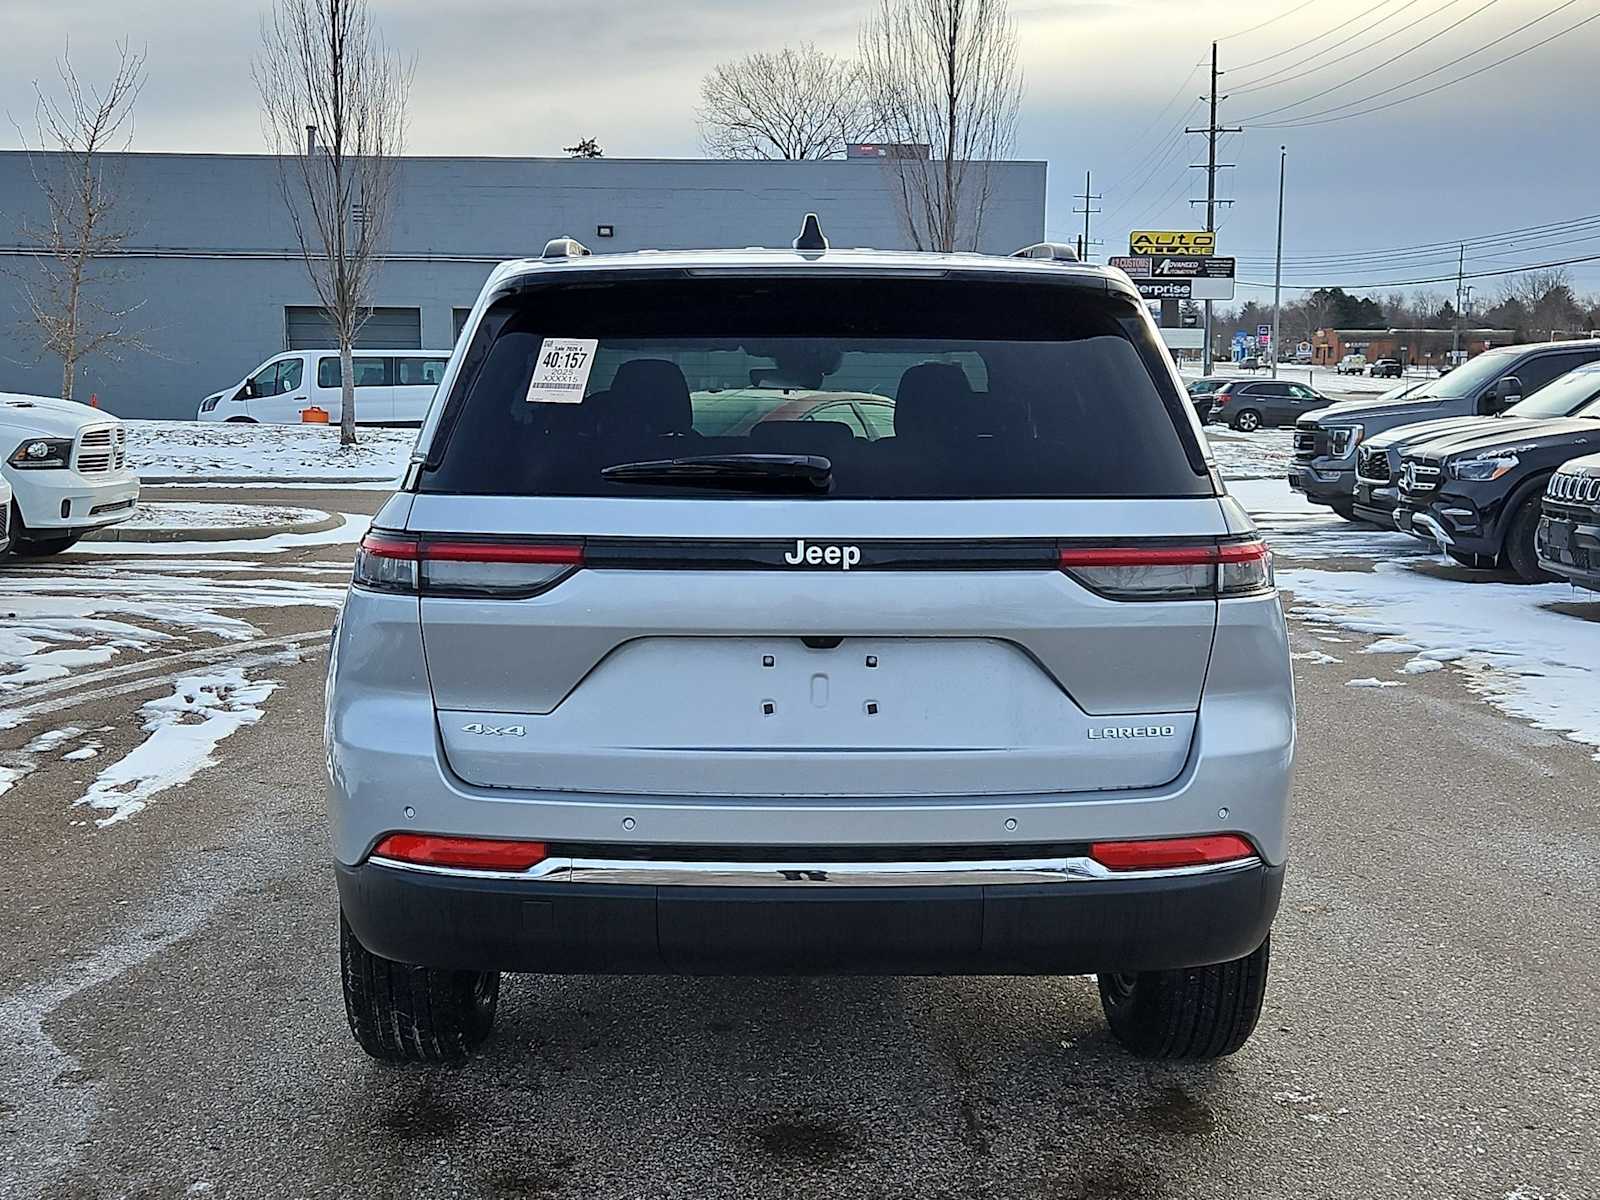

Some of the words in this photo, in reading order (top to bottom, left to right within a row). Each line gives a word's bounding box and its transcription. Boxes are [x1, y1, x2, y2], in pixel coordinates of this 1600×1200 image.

[1132, 246, 1213, 255] VILLAGE
[785, 540, 860, 570] Jeep
[461, 724, 526, 736] 4x4
[1087, 726, 1176, 739] LAREDO
